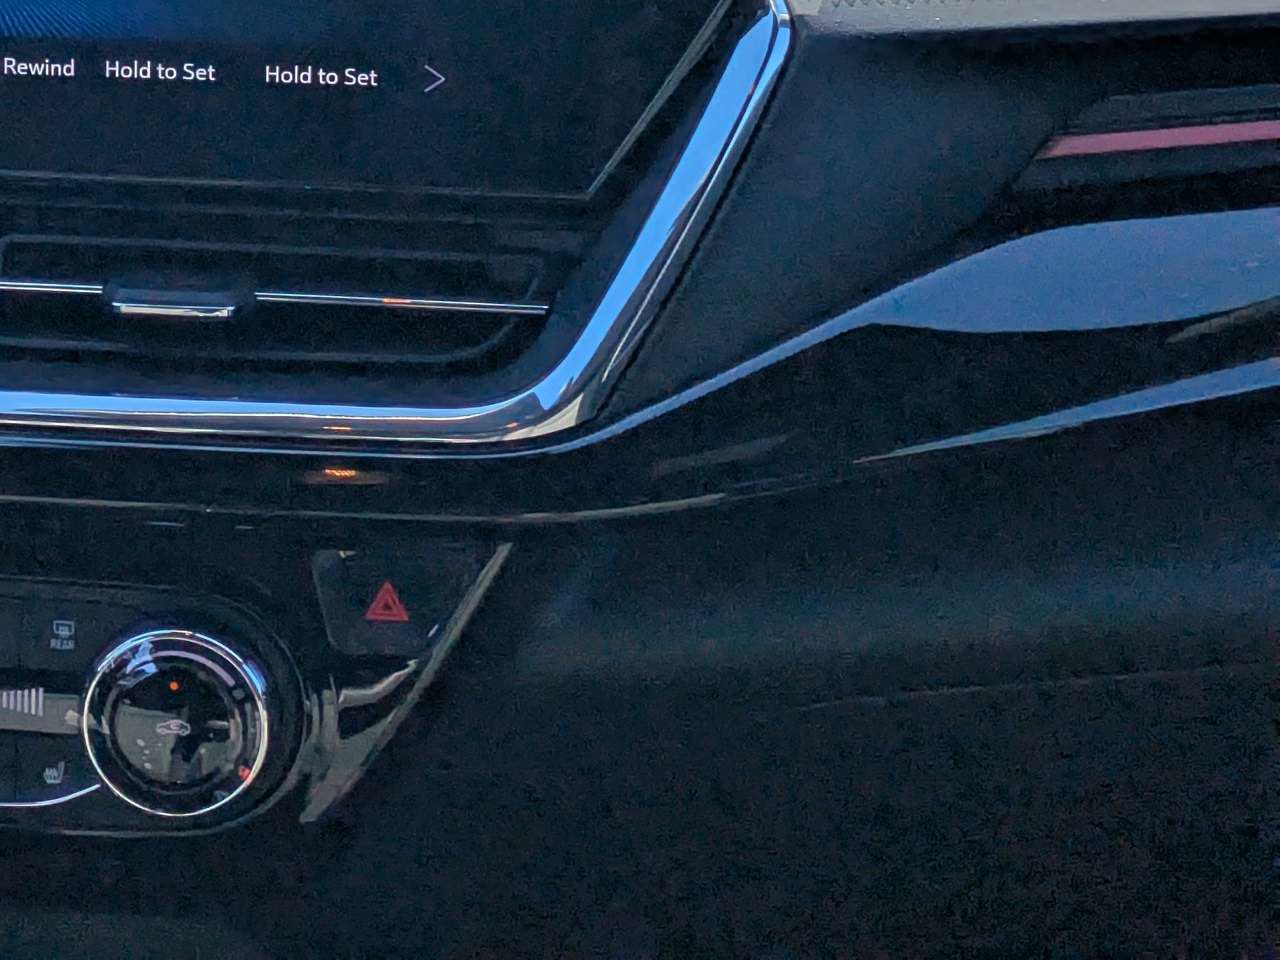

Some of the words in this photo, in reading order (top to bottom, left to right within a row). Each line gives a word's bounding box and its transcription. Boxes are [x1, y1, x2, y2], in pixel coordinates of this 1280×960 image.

[3, 58, 75, 77] Rewind
[105, 60, 152, 79] Hold
[156, 64, 177, 80] to
[182, 63, 216, 81] Set
[265, 65, 313, 84] Hold
[318, 69, 339, 85] to
[343, 68, 379, 86] Set
